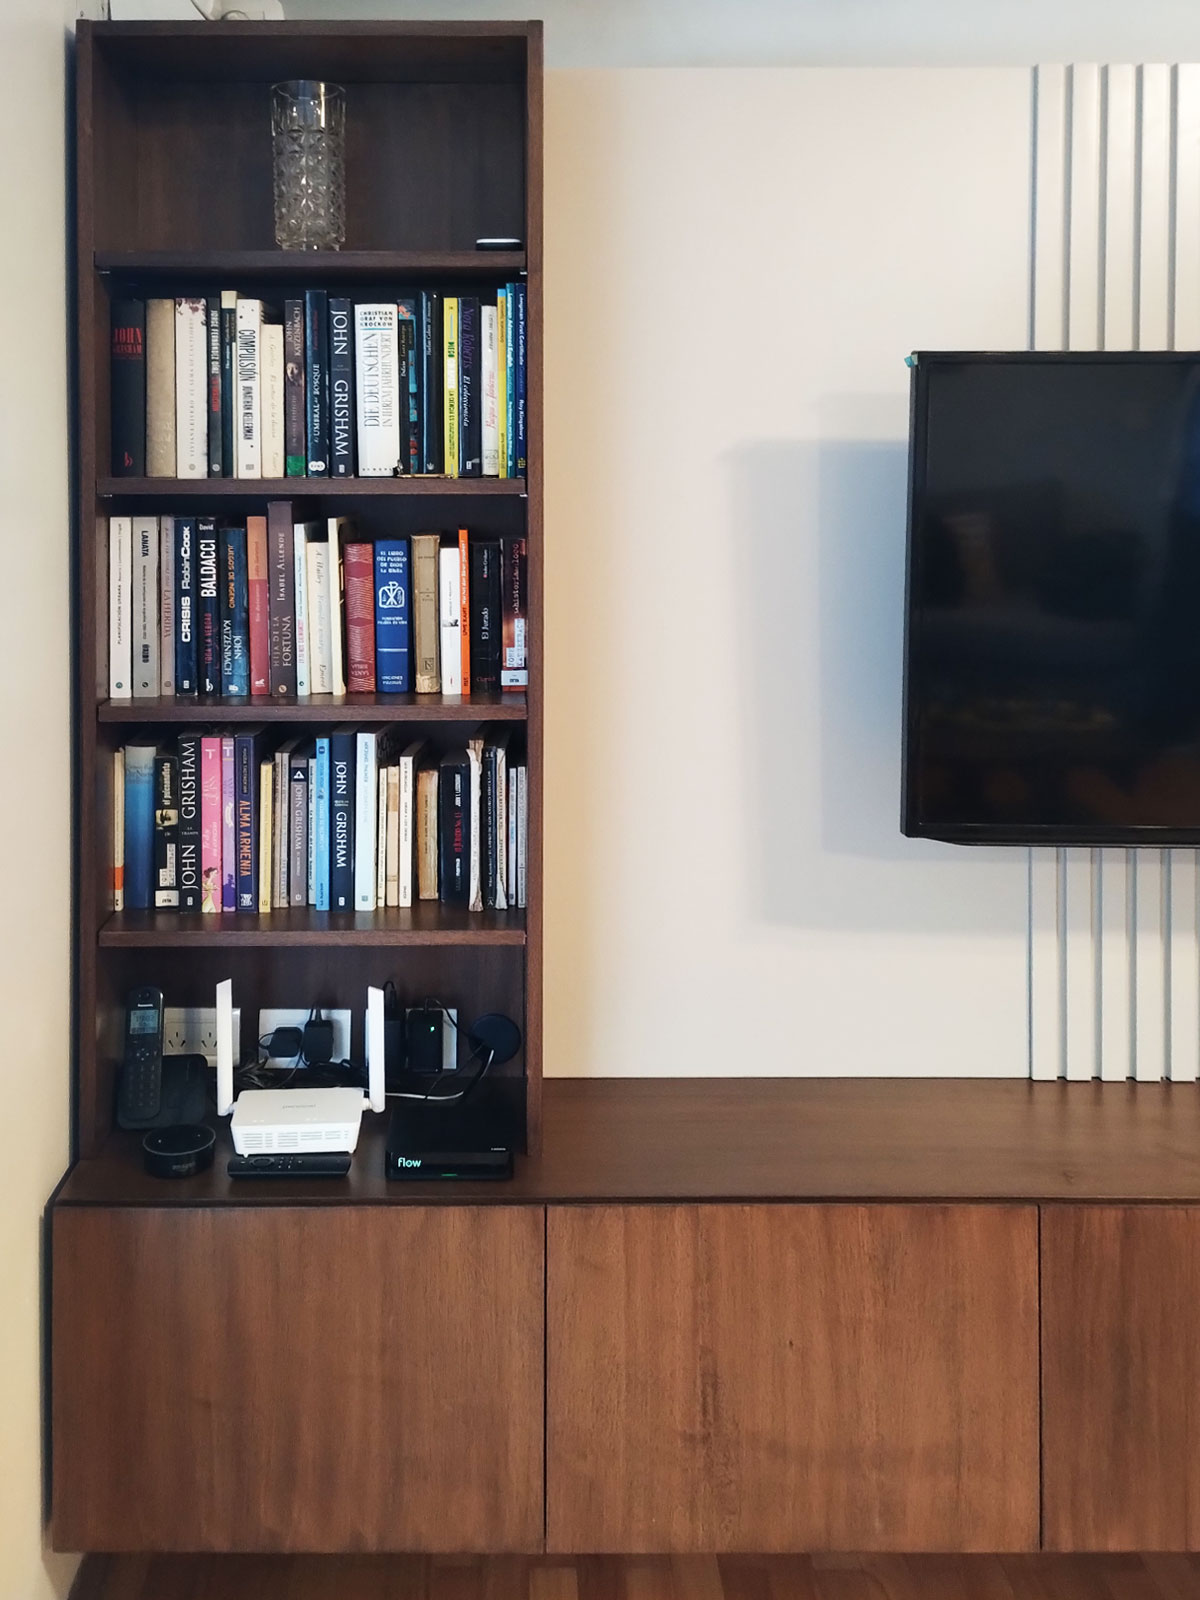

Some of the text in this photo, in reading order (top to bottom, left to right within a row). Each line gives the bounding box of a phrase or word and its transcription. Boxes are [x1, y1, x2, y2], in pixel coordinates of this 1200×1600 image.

[114, 328, 142, 343] JOHN
[211, 310, 219, 327] JORGE
[331, 311, 348, 355] JOHN
[462, 308, 475, 369] Nora Roberts
[239, 329, 258, 382] COMPULSIÓN
[362, 333, 380, 427] DIE DEUTSCHEN
[381, 333, 393, 389] JAHRHUNDERT
[242, 386, 254, 440] JONATHAN KELLERMAN
[334, 379, 348, 456] GRISHAM
[381, 391, 393, 417] IHREM
[463, 375, 471, 427] El coleccionista
[141, 530, 150, 557] LANATA
[200, 539, 216, 597] BALDACCI
[276, 532, 286, 601] ISABEL ALLENDE
[228, 544, 236, 609] JUEGOS DE INGENIO
[315, 561, 324, 584] Hailey
[163, 589, 171, 639] LA HERIDA
[181, 596, 191, 642] CRISIS
[273, 616, 279, 628] LA
[273, 630, 279, 642] DE
[482, 632, 489, 640] El
[223, 619, 233, 675] KATZENBACH
[233, 634, 241, 660] JOHN
[282, 615, 291, 667] FORTUNA
[181, 741, 196, 819] GRISHAM
[334, 761, 347, 794] JOHN
[240, 800, 251, 876] ALMA ARMENIA
[295, 784, 304, 850] JOHN GRISHAM
[336, 811, 347, 868] GRISHAM
[182, 845, 199, 889] JOHN
[398, 1157, 422, 1168] flow
